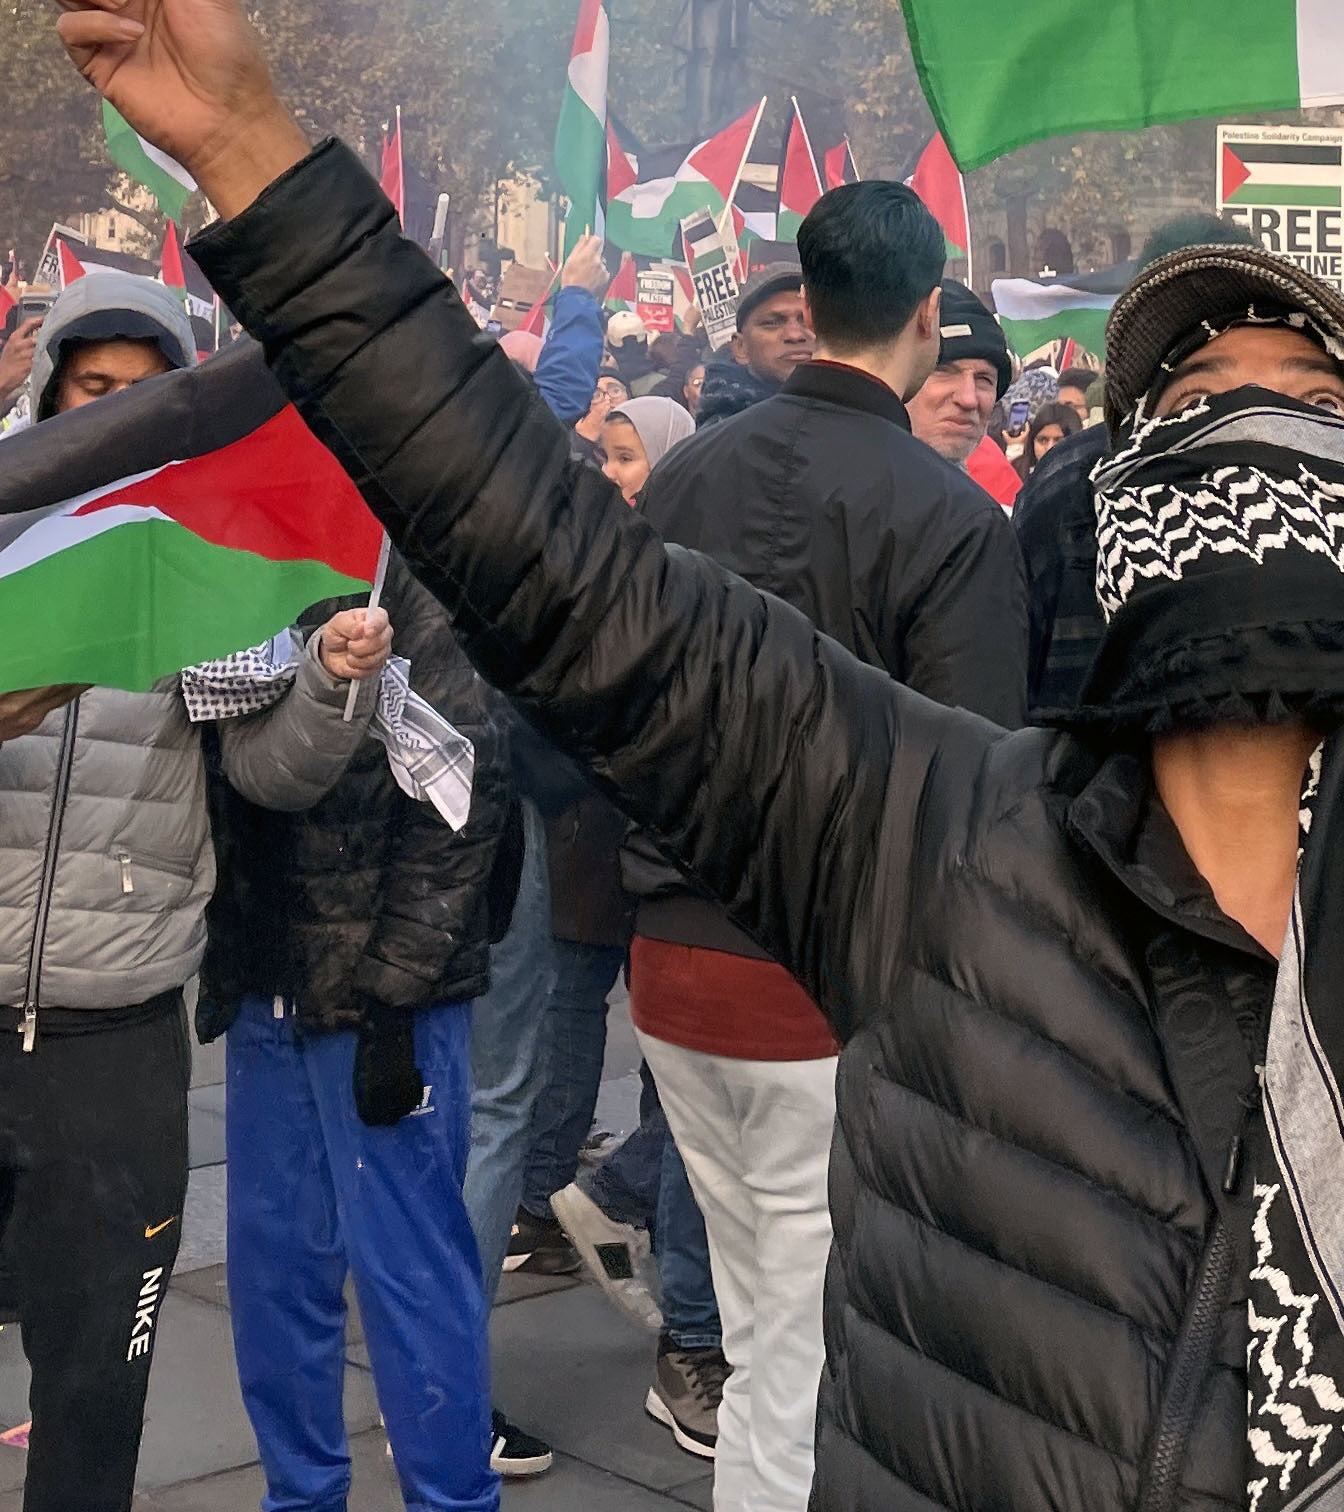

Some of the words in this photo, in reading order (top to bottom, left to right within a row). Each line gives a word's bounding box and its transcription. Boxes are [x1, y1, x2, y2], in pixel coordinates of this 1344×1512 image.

[1222, 130, 1260, 140] Palestine
[1262, 131, 1300, 142] Solidarity
[1302, 133, 1343, 144] Campaign
[692, 263, 737, 309] FREE
[126, 1266, 163, 1362] NIKE
